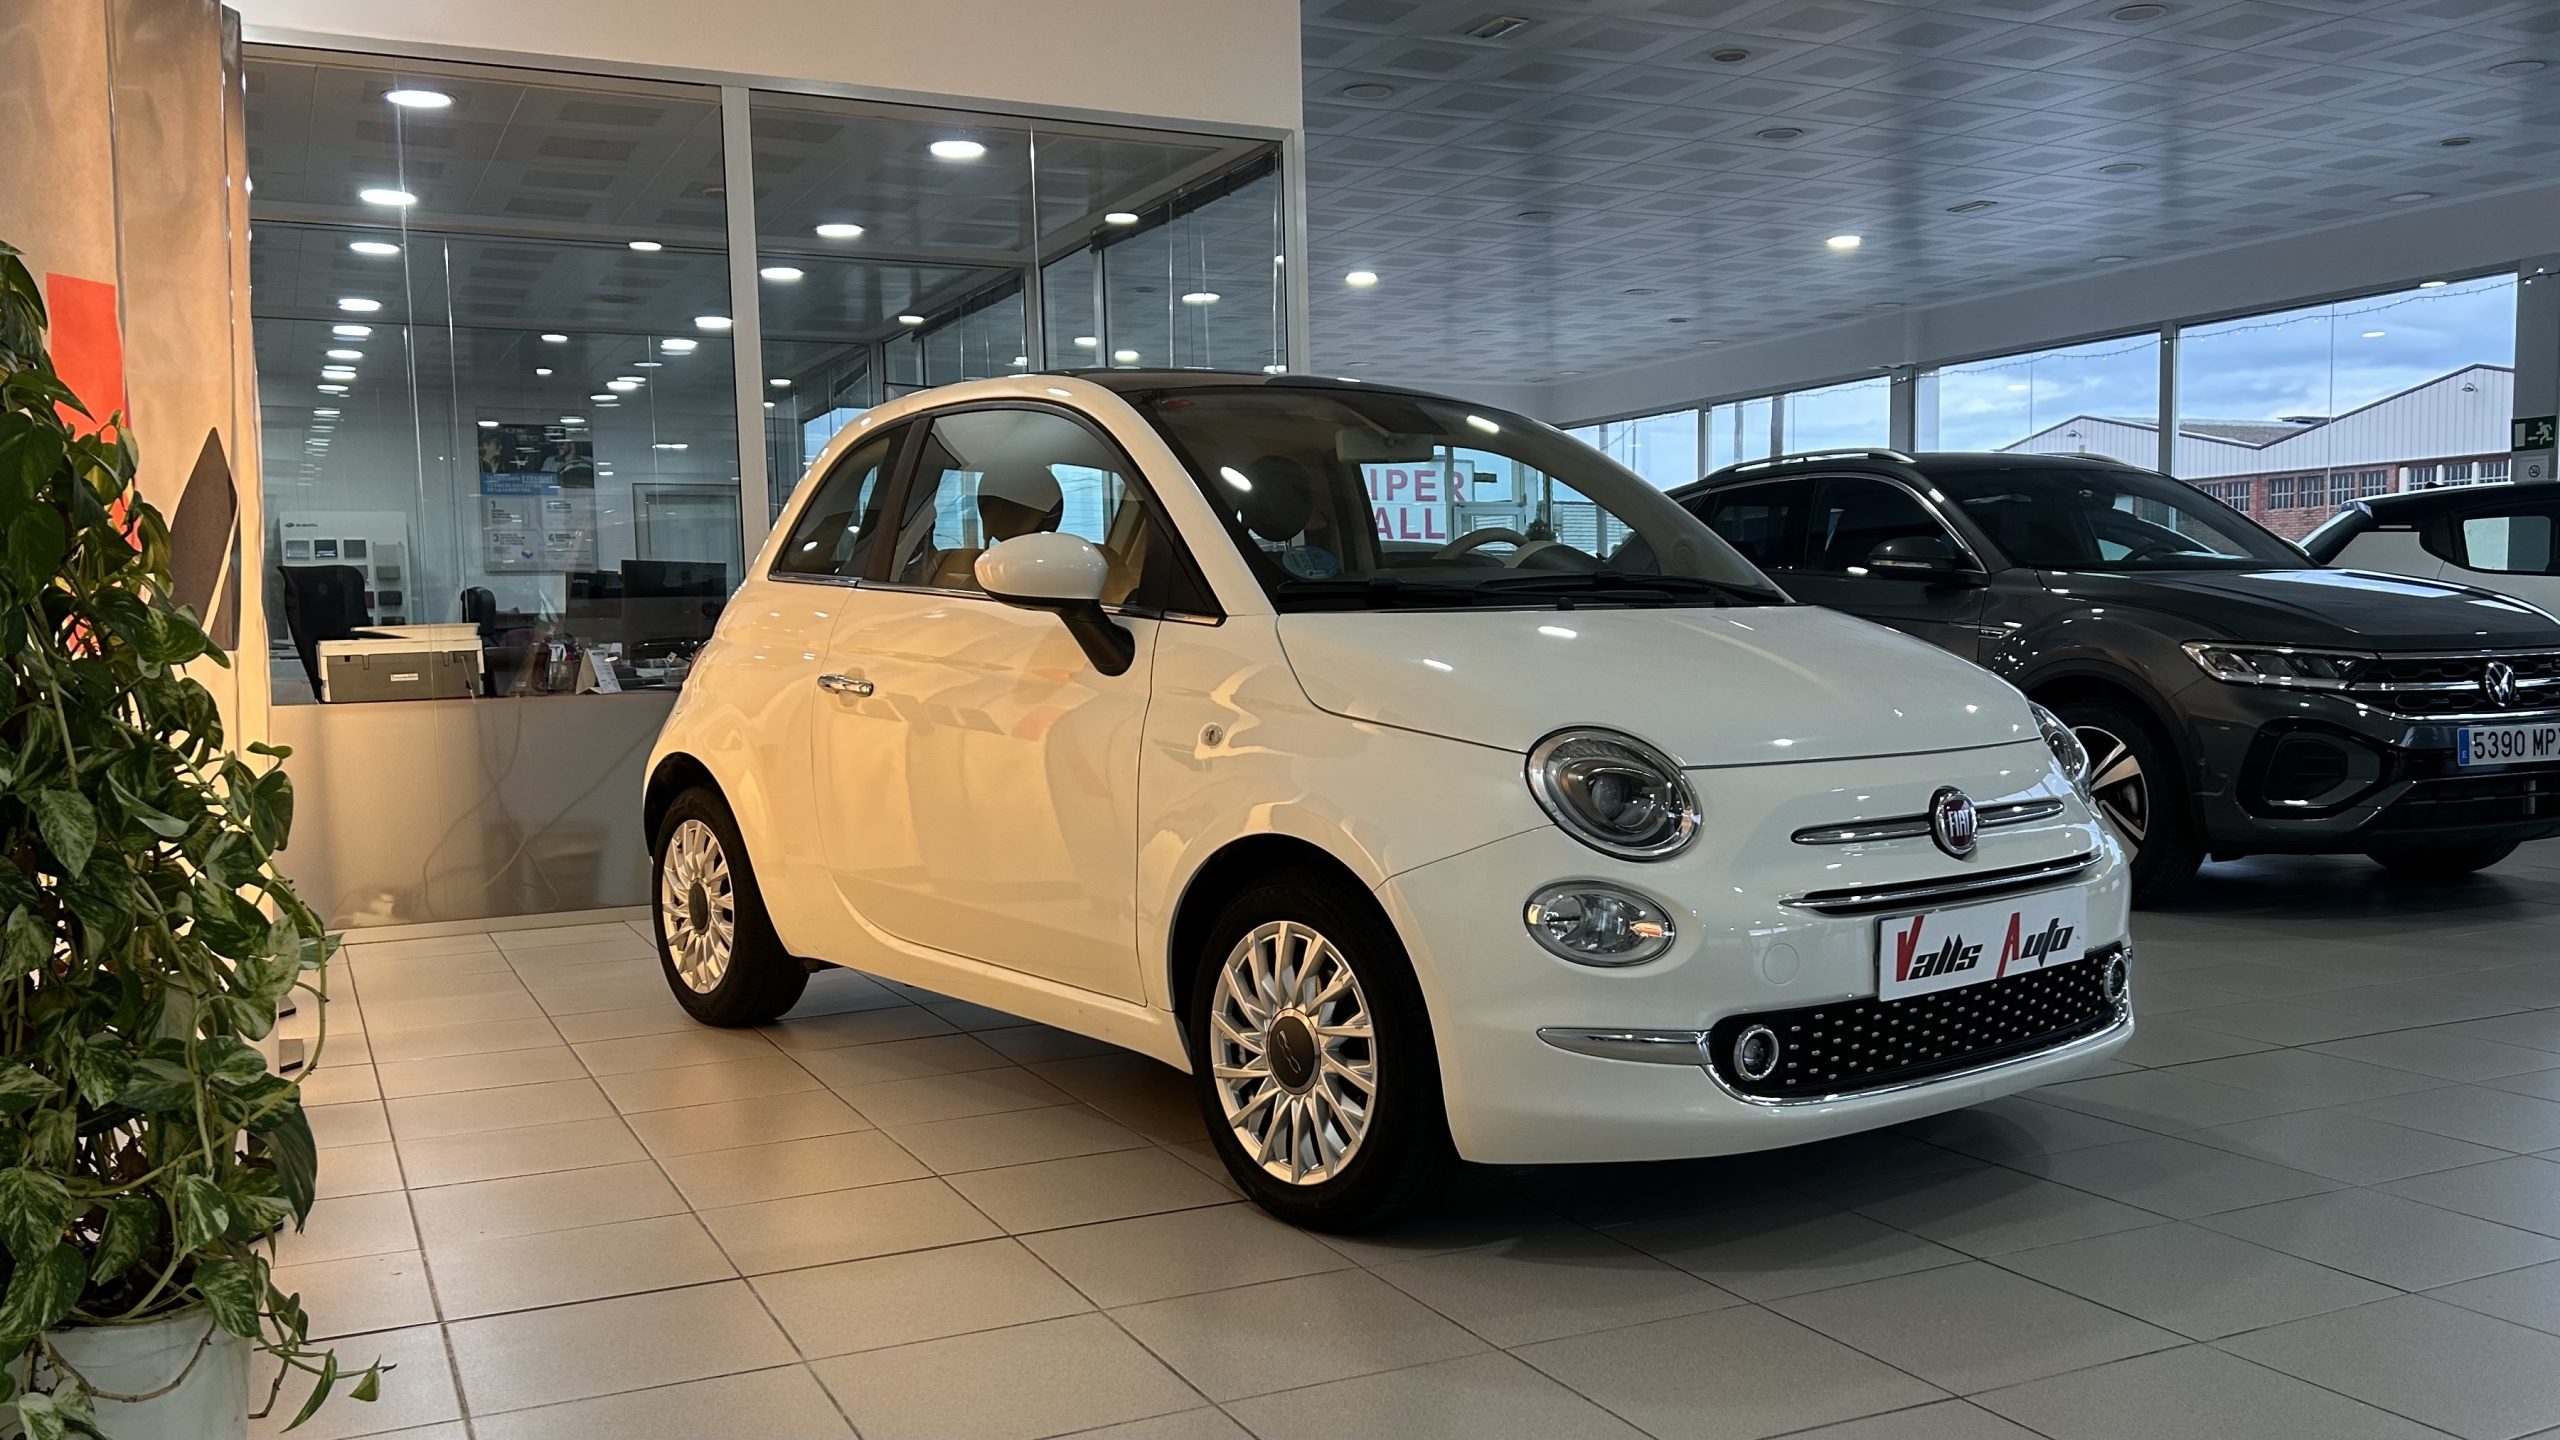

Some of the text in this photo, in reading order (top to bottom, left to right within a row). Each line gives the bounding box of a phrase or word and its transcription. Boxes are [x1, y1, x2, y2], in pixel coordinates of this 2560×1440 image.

[2473, 730, 2526, 760] 5390
[1947, 809, 1971, 837] FIAT
[1895, 911, 2075, 982] Valls Auto
